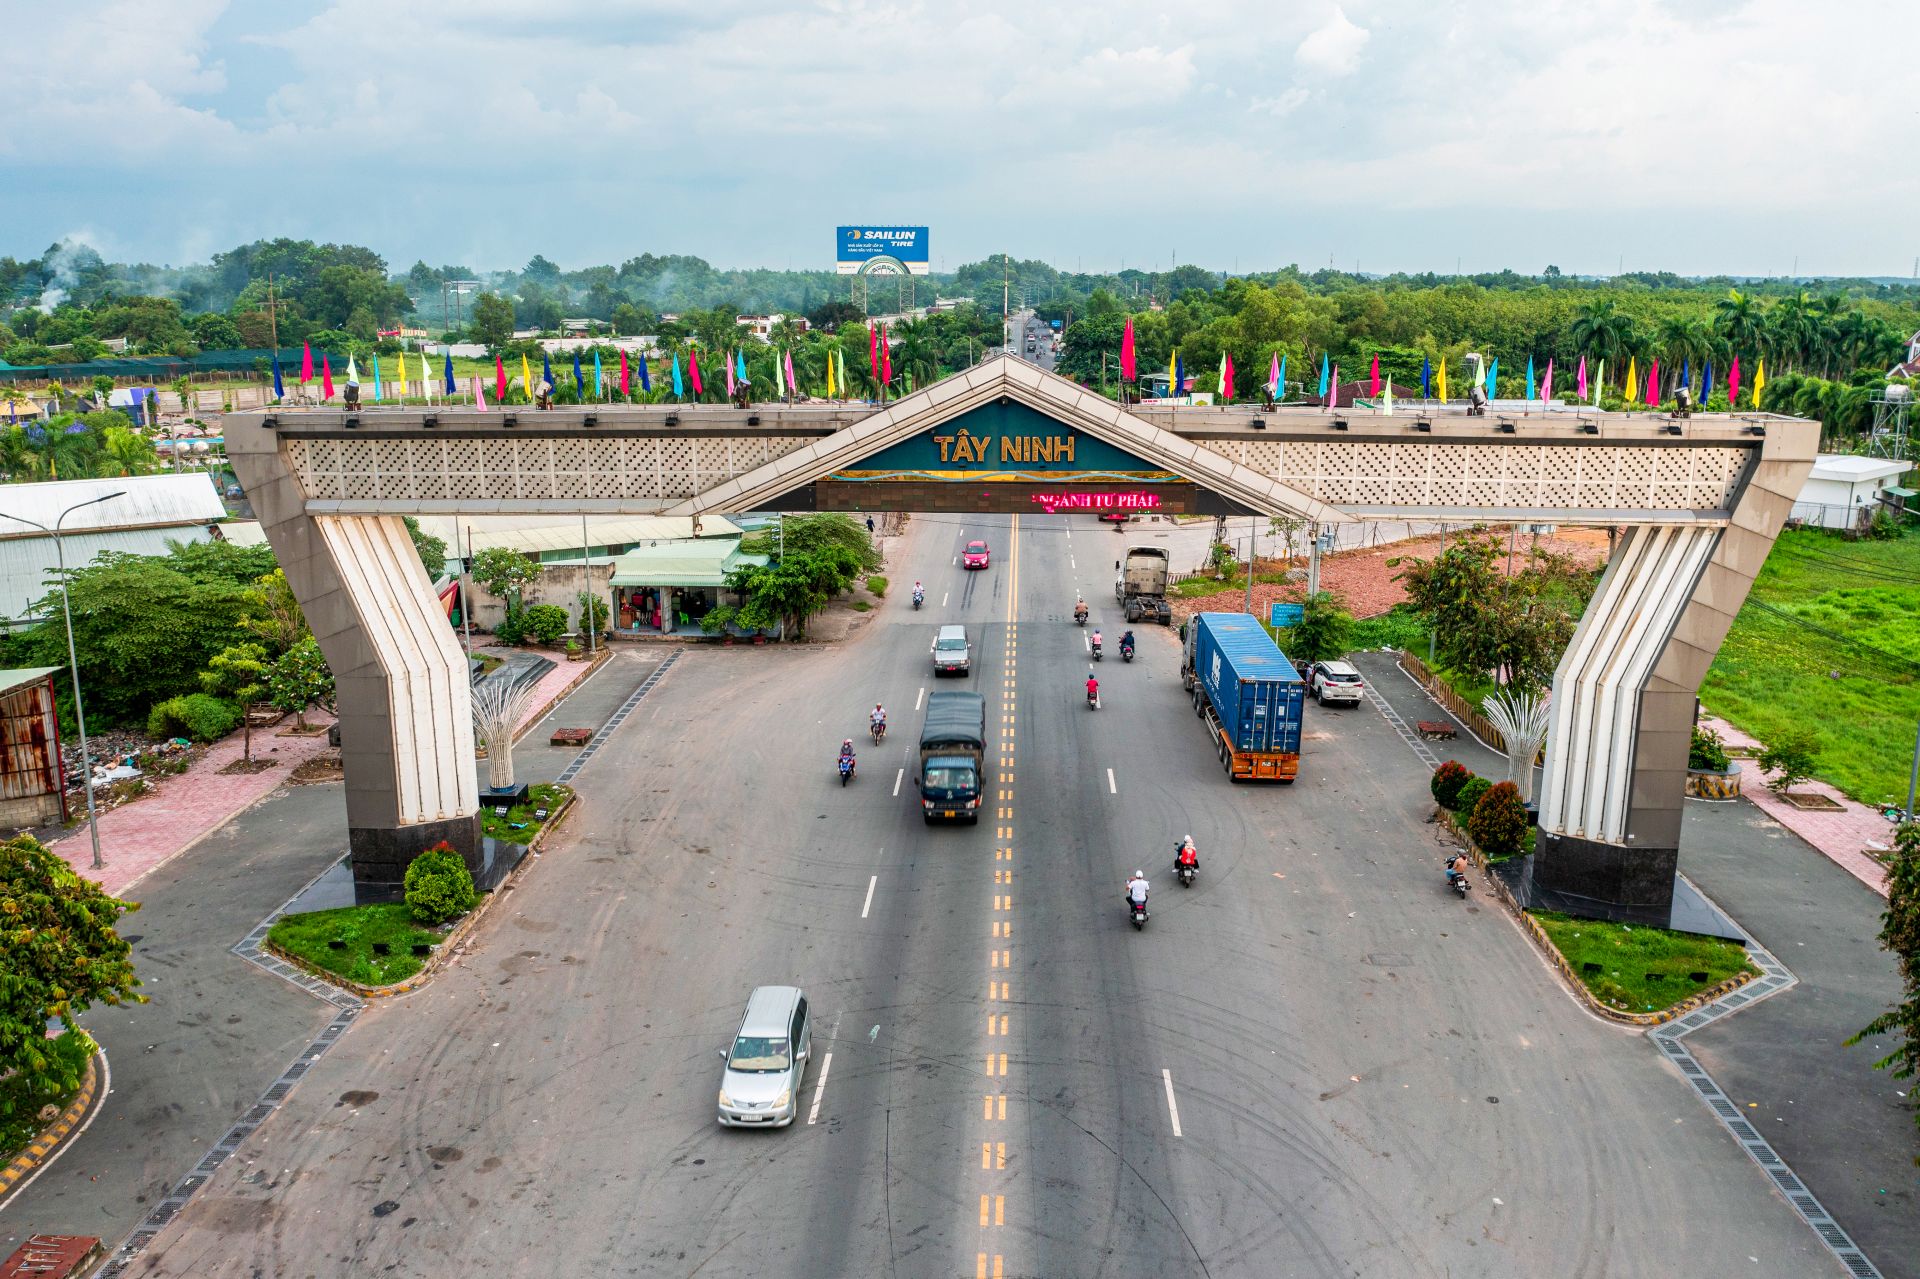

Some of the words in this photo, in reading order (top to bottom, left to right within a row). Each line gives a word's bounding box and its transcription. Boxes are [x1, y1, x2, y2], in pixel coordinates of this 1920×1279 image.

[864, 231, 915, 240] SAILUN
[934, 428, 992, 462] TÂY
[1001, 436, 1075, 462] NINH
